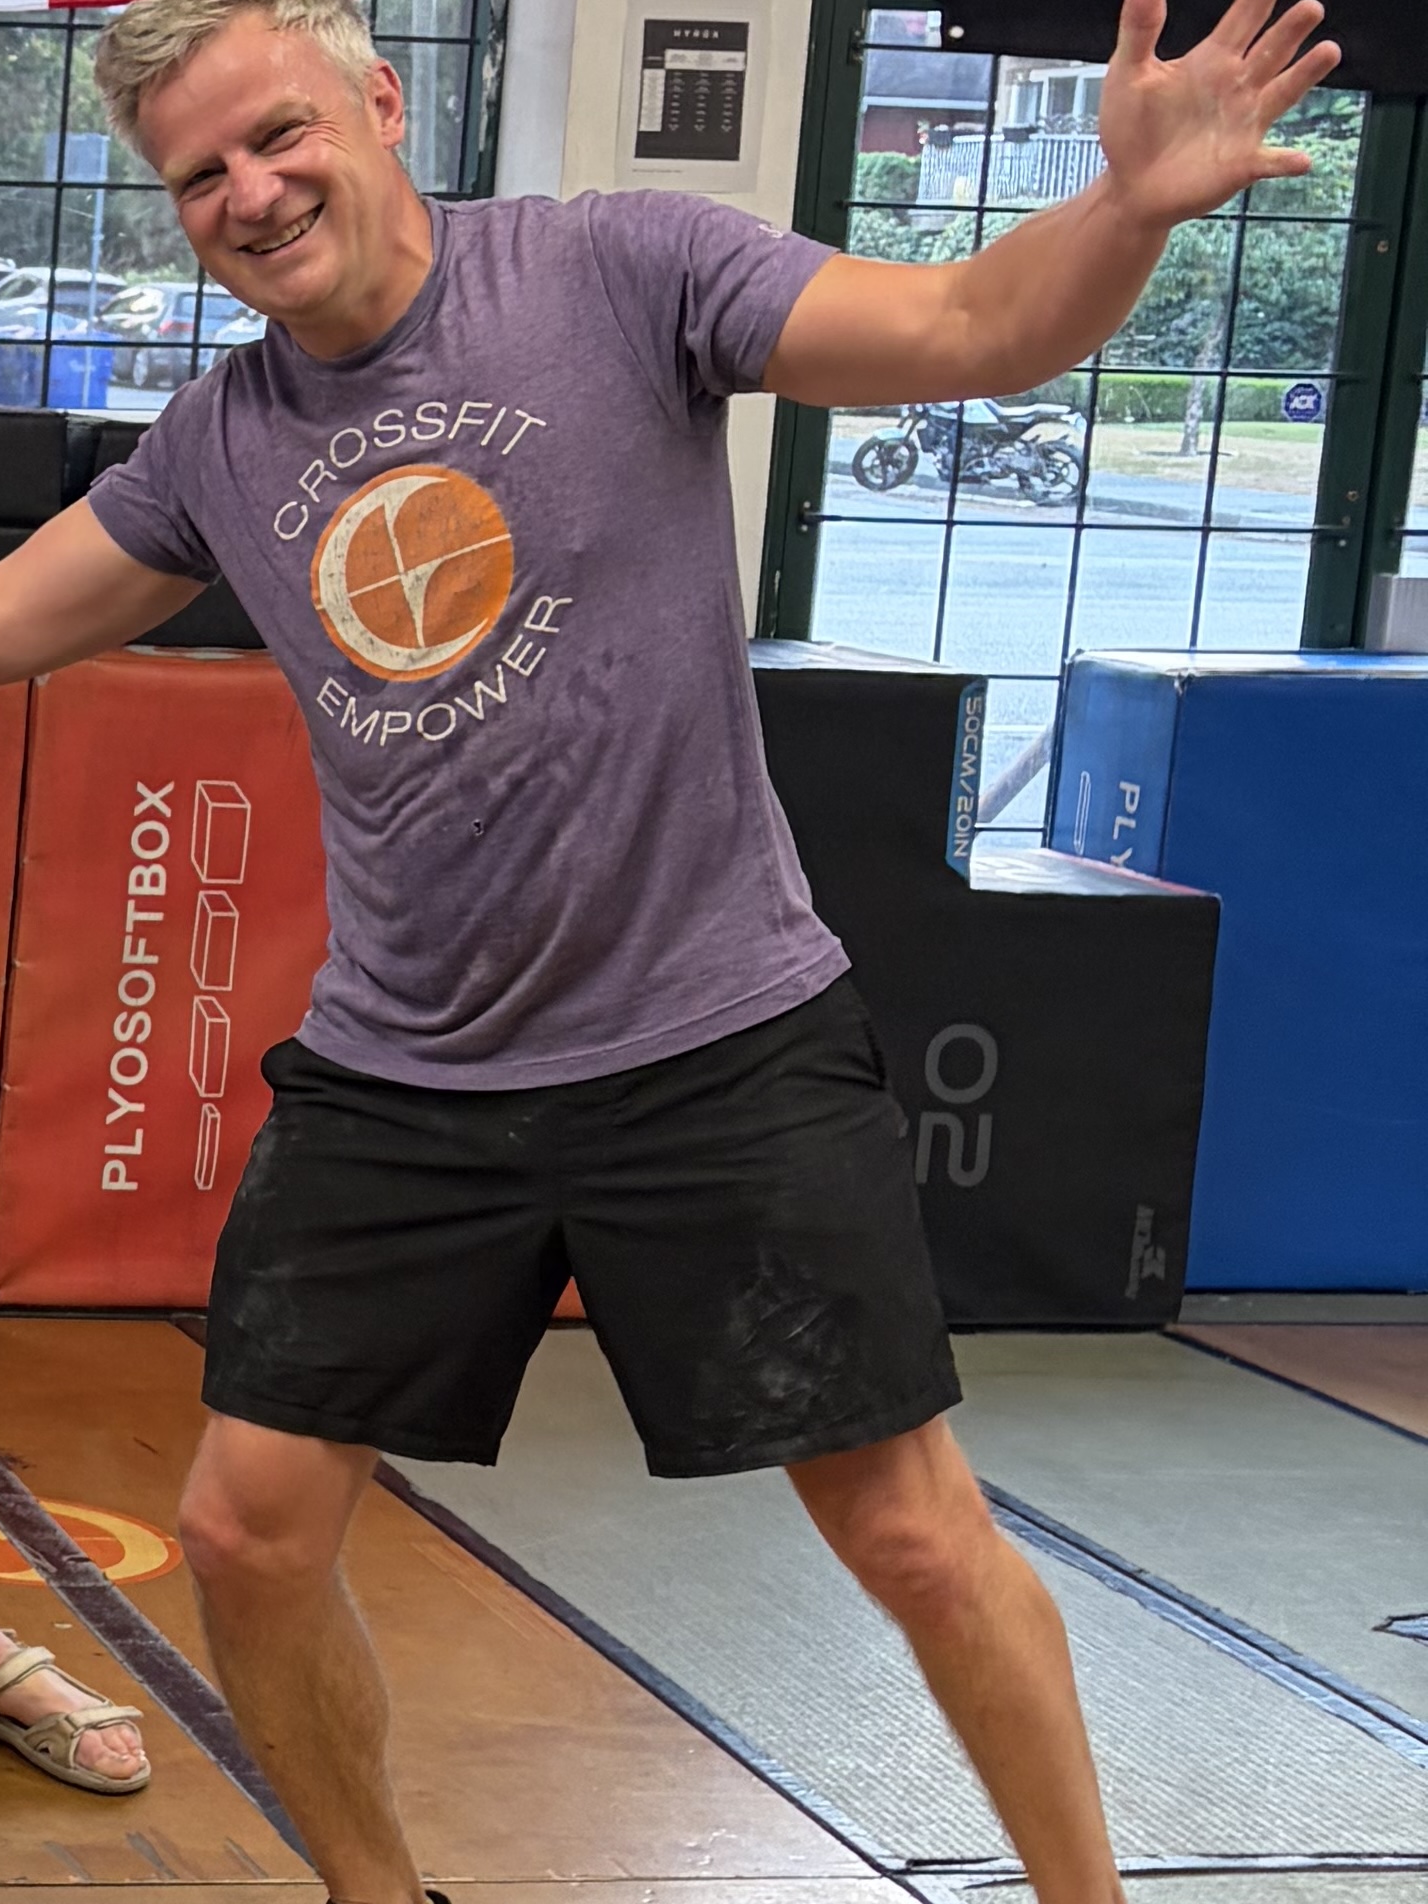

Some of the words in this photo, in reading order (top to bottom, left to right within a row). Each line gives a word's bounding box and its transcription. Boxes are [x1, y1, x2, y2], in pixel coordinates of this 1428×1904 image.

[273, 400, 547, 542] CROSSFIT
[316, 594, 574, 747] EMPOWER
[952, 695, 984, 860] 50CM/20IN
[101, 780, 175, 1192] PLYOSOFTBOX
